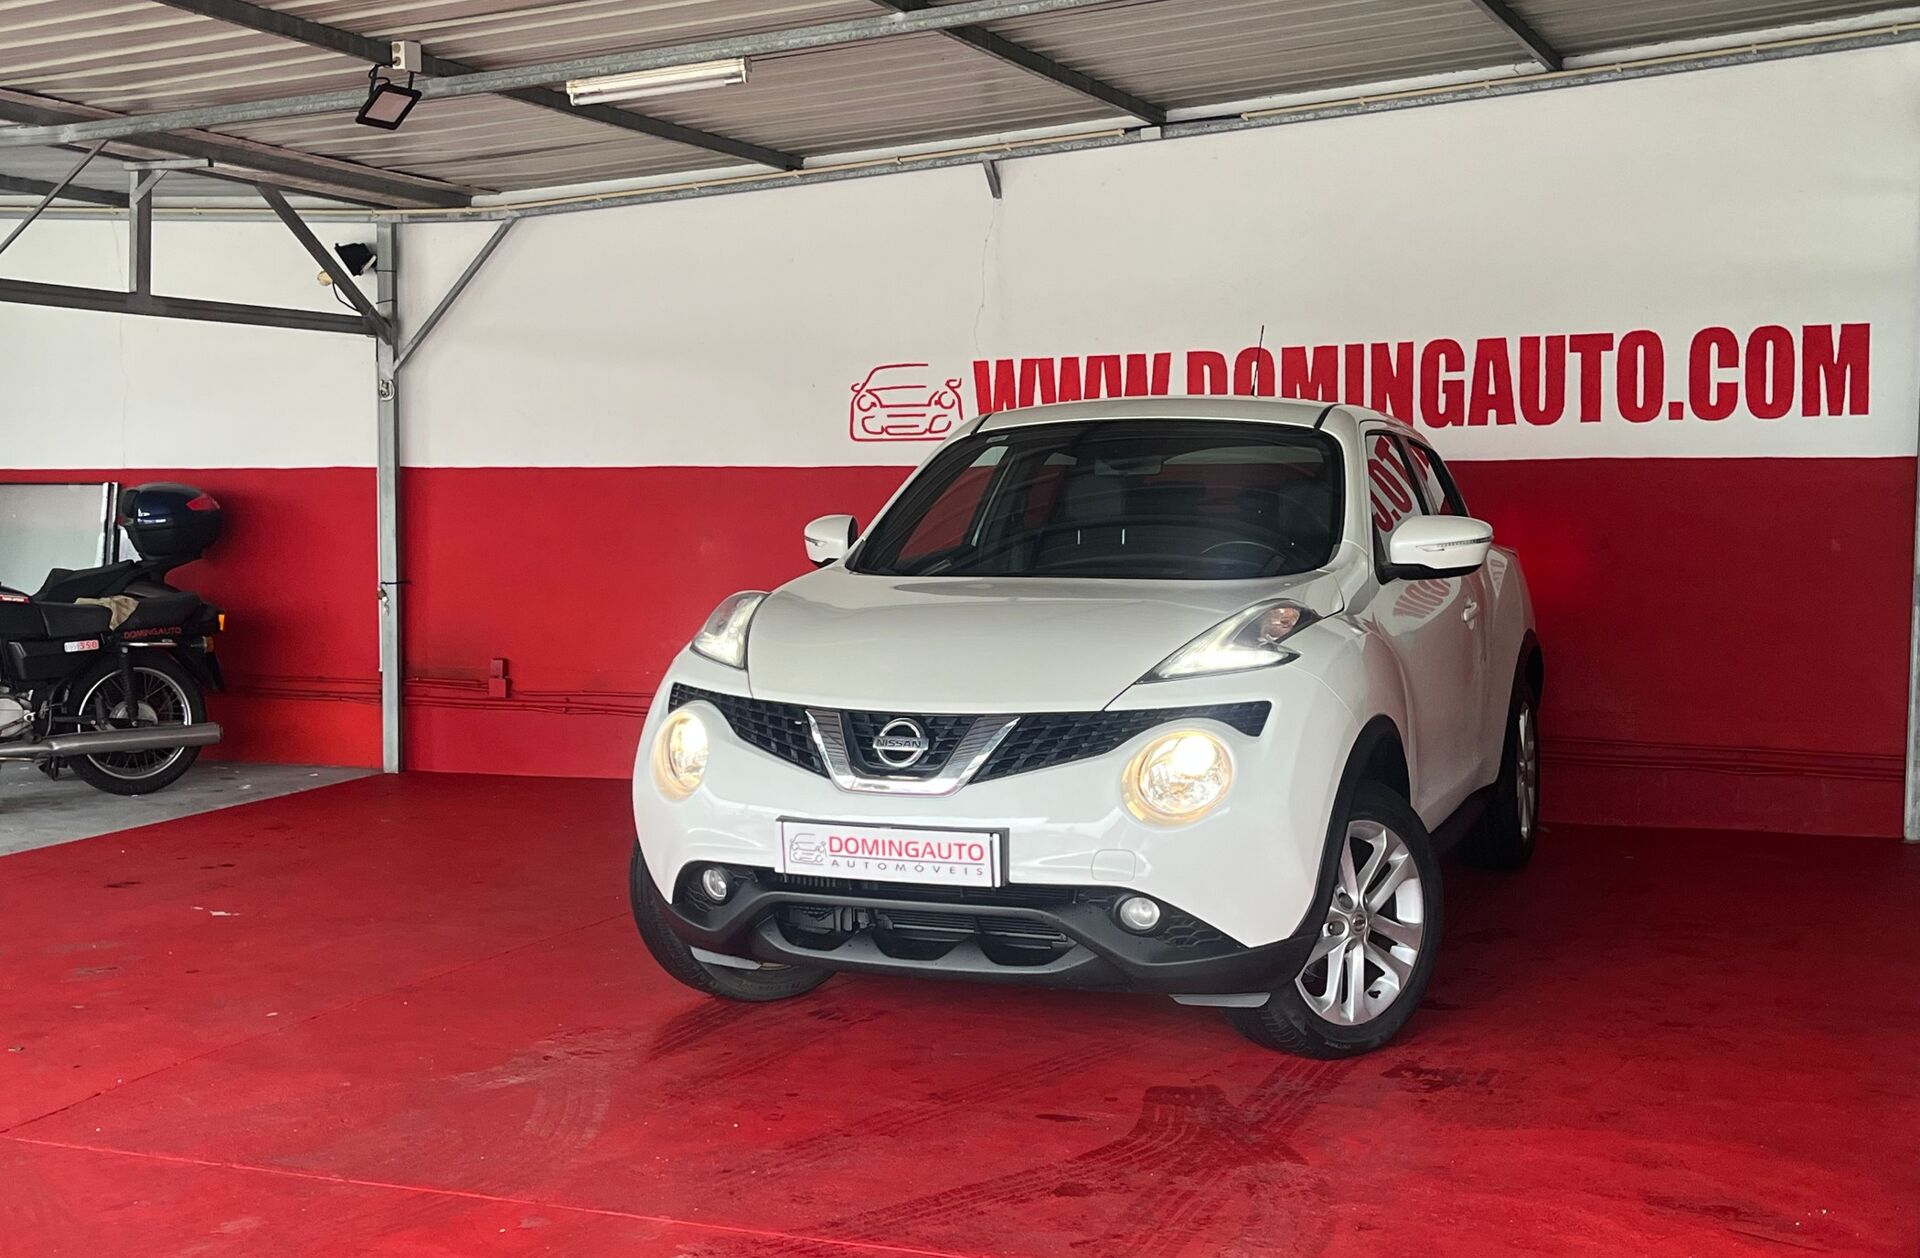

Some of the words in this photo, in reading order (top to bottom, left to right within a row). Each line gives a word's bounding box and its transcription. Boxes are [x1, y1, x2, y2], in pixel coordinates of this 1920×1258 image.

[877, 738, 922, 749] NISSAN
[828, 836, 984, 861] DOMINGAUTO
[831, 858, 984, 876] AUTOMÓVEIS
